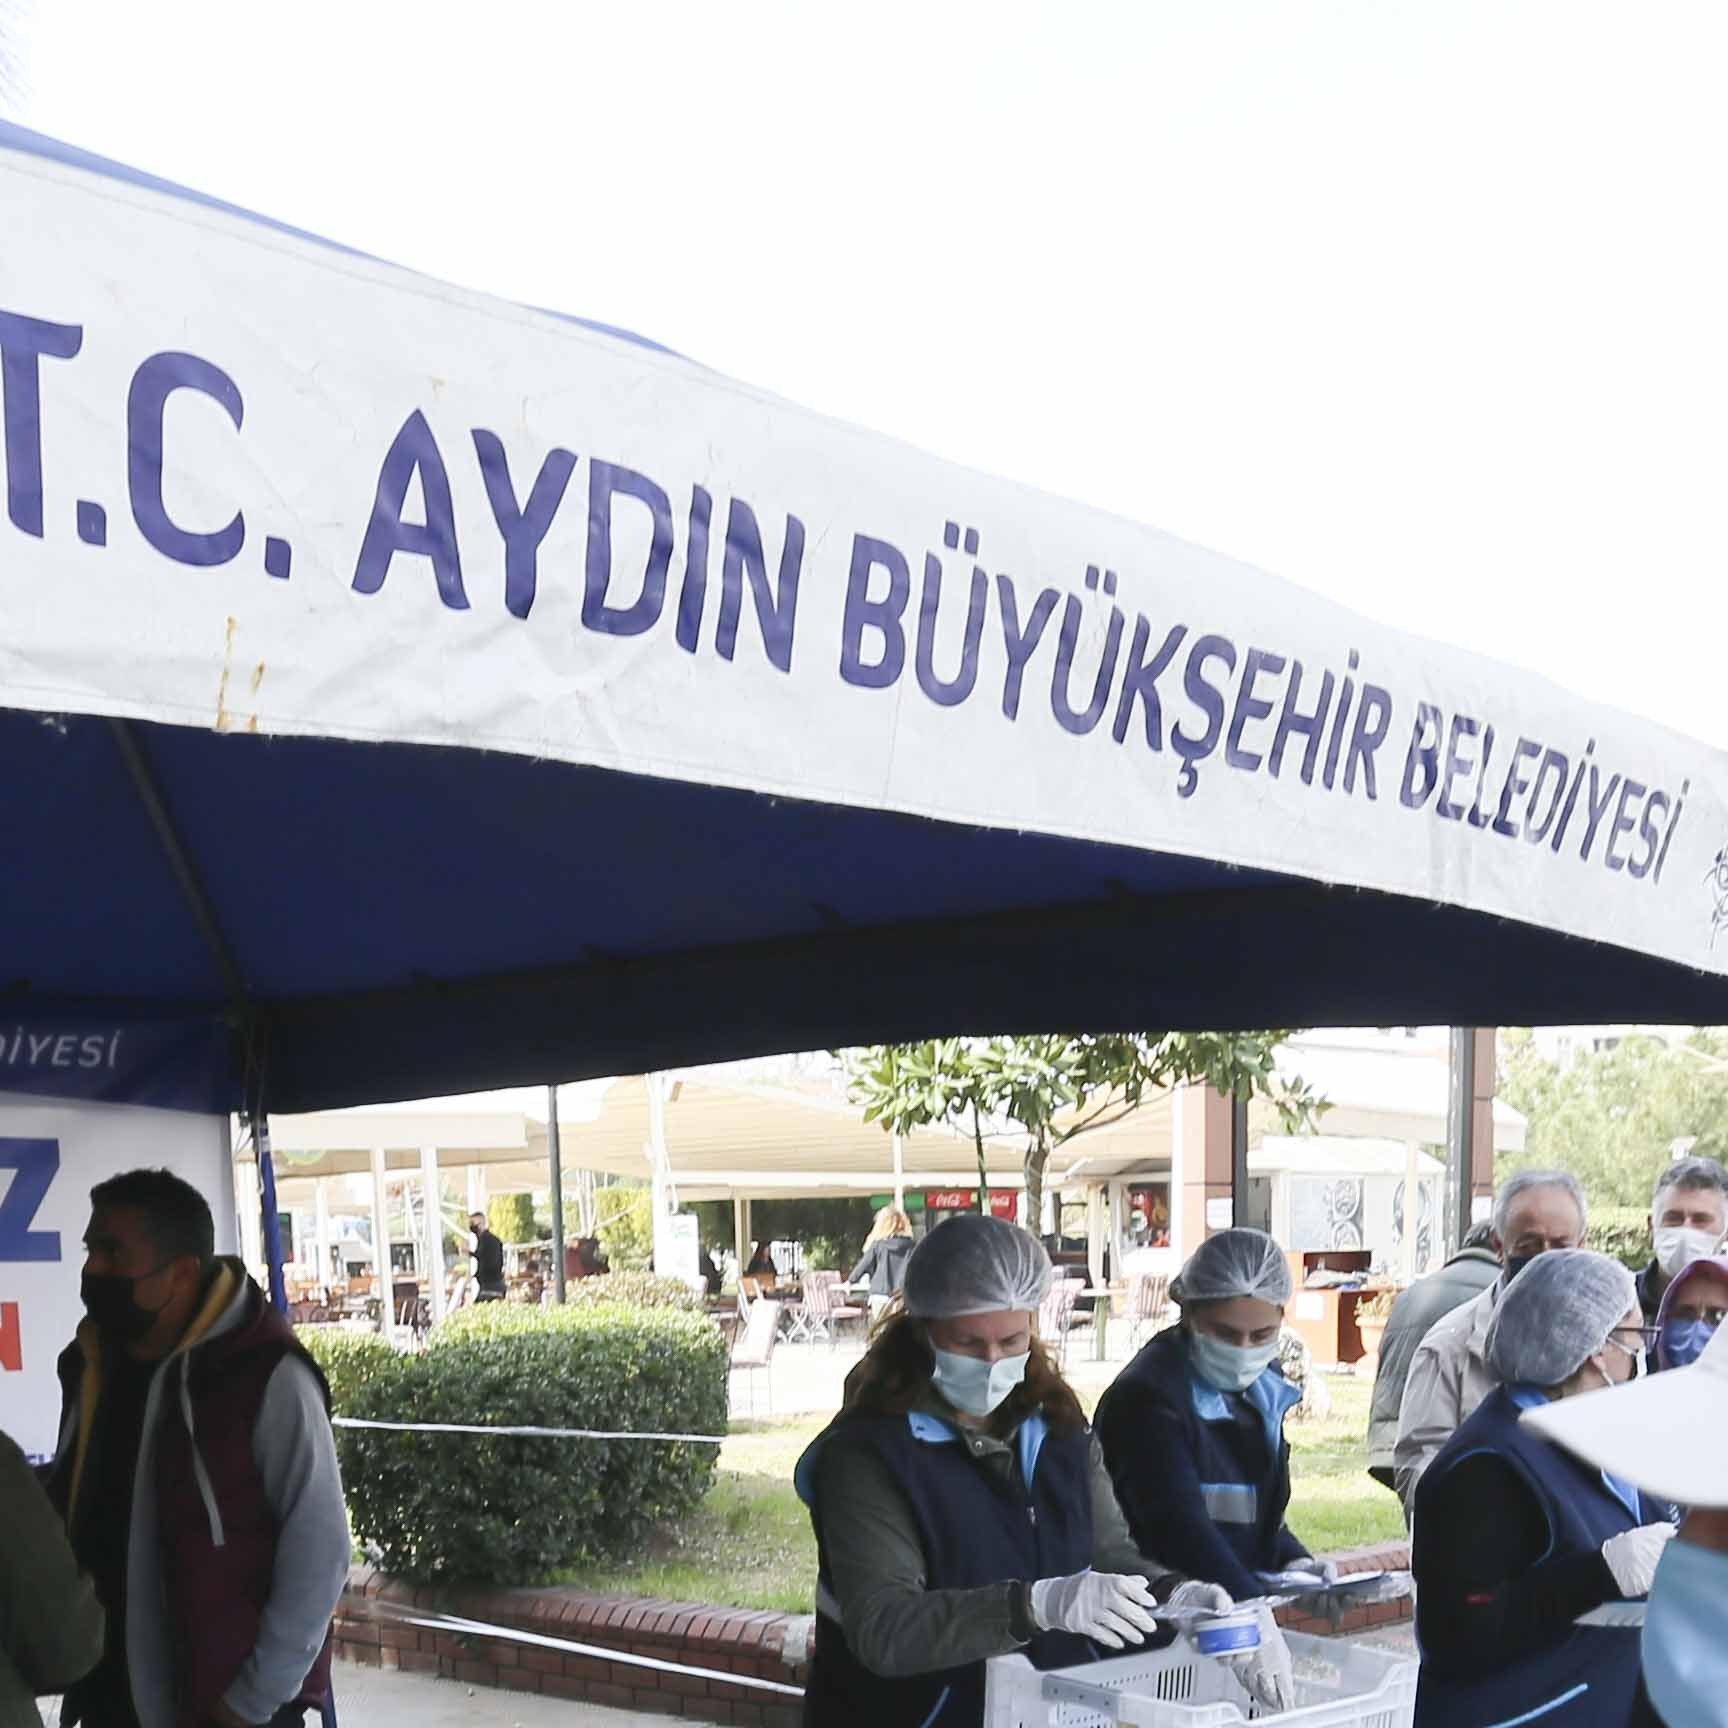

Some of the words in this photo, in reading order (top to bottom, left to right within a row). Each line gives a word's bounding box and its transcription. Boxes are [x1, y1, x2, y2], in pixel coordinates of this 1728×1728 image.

[350, 408, 805, 673] AYDIN
[839, 520, 1393, 798] BÜYÜKŞEHİR
[1400, 702, 1689, 884] BELEDİYESİ
